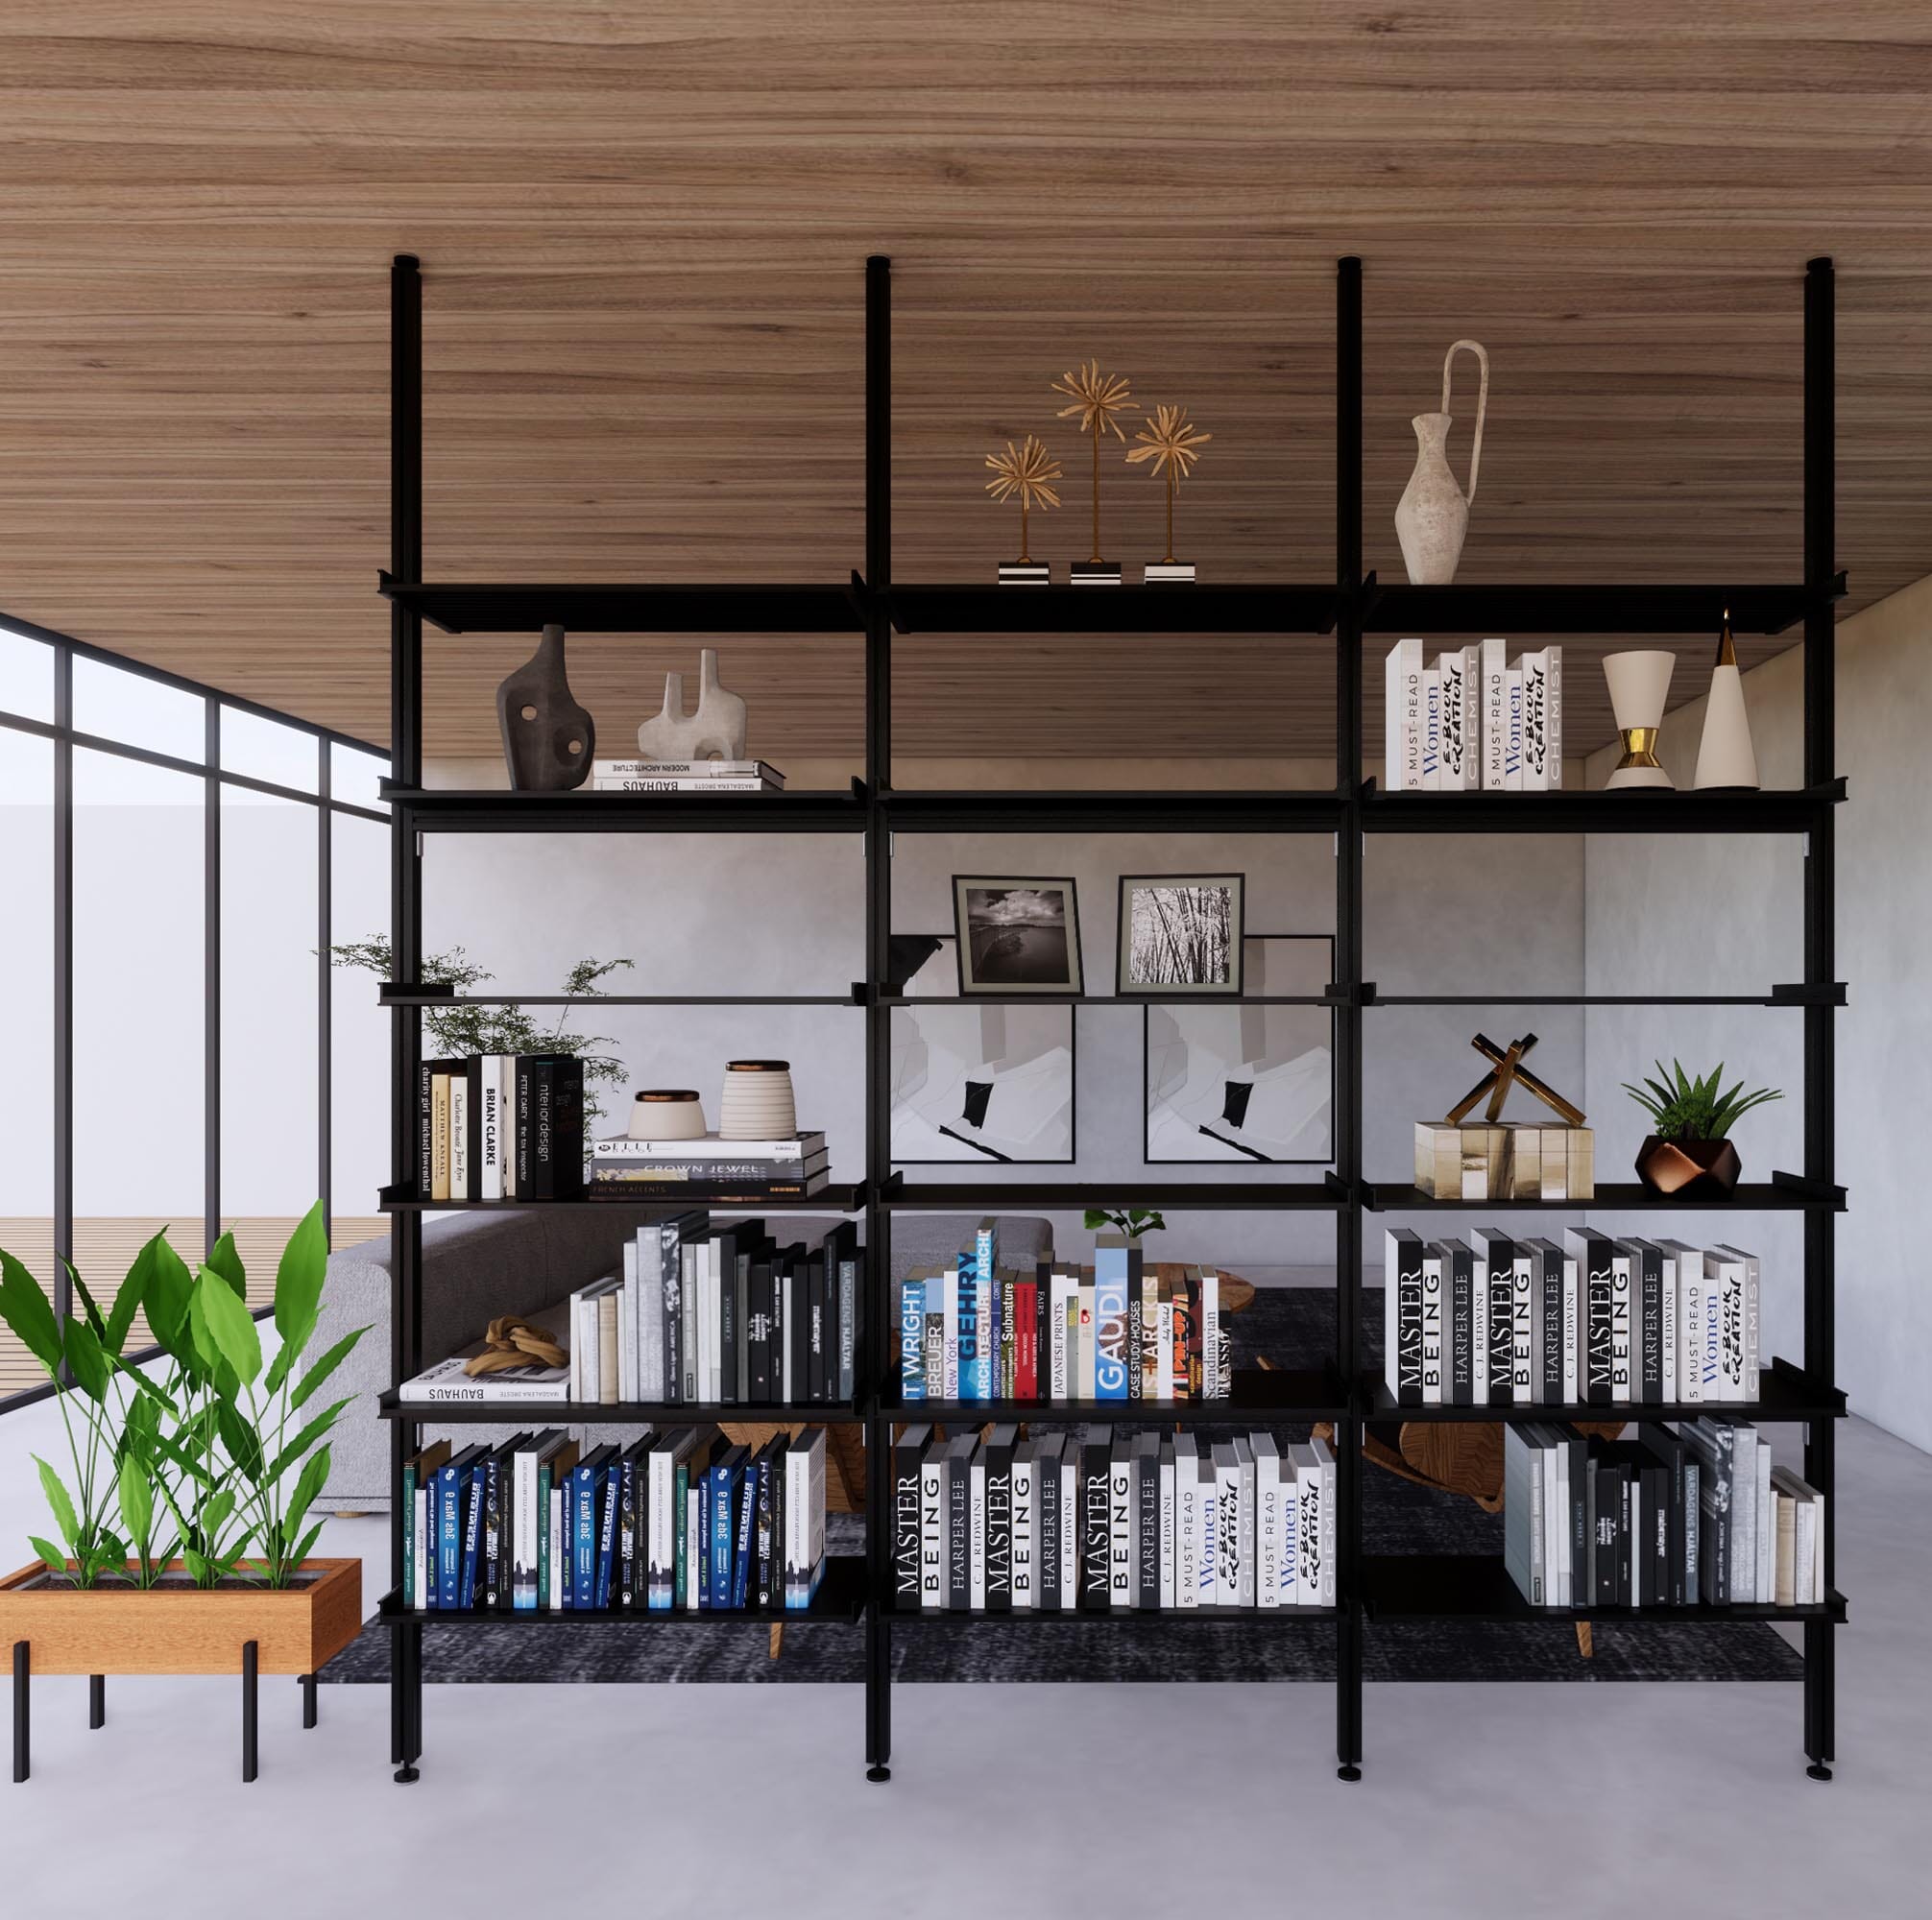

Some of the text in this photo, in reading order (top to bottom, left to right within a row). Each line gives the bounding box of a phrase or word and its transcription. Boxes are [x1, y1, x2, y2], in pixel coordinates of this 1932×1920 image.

[1409, 674, 1418, 770] MUST-READ
[1422, 685, 1438, 776] Women
[1443, 677, 1453, 765] E-BOOK
[1467, 654, 1477, 780] CHEMIST
[1491, 674, 1501, 770] MUST-READ
[1505, 685, 1521, 776] Women
[1525, 677, 1535, 765] E-BOOK
[1551, 654, 1560, 780] CHEMIST
[622, 781, 678, 791] BAUHAUS
[422, 1067, 430, 1095] charity
[422, 1097, 430, 1113] girl
[486, 1088, 495, 1165] BRIAN CLARKE
[538, 1123, 550, 1162] design
[644, 1164, 759, 1174] CROWN JEWEL
[902, 1285, 921, 1381] WRIGHT
[958, 1252, 978, 1361] GEHRY
[978, 1287, 990, 1399] ARCHITECTURE
[1002, 1283, 1014, 1342] Subnature
[1054, 1303, 1064, 1394] JAPANESE PRINTS
[1130, 1300, 1141, 1399] CASE STUDY HOUSES
[1173, 1310, 1186, 1372] PIN-UP
[1399, 1268, 1422, 1389] MASTER
[1424, 1274, 1440, 1386] BEING
[1456, 1274, 1468, 1383] HARPER LEE
[1490, 1267, 1512, 1388] MASTER
[1514, 1273, 1530, 1385] BEING
[1546, 1273, 1558, 1382] HARPER LEE
[1566, 1289, 1575, 1349] REDWINE
[1589, 1266, 1611, 1387] MASTER
[1613, 1272, 1628, 1385] BEING
[1645, 1273, 1657, 1382] HARPER LEE
[1665, 1288, 1674, 1349] REDWINE
[1689, 1286, 1698, 1399] 5 MUST-READ
[1703, 1295, 1718, 1384] Women
[1722, 1289, 1733, 1375] E-BOOK
[1749, 1266, 1758, 1392] CHEMIST
[428, 1389, 484, 1400] BAUHAUS
[928, 1326, 942, 1397] BREUER
[945, 1337, 957, 1398] New York
[1203, 1310, 1217, 1400] Scandinavian
[896, 1474, 919, 1595] MASTER
[924, 1478, 939, 1591] BEING
[953, 1479, 965, 1590] HARPER LEE
[987, 1473, 1009, 1594] MASTER
[1015, 1477, 1030, 1590] BEING
[1044, 1479, 1055, 1589] HARPER LEE
[1086, 1472, 1109, 1594] MASTER
[1113, 1476, 1128, 1589] BEING
[1142, 1478, 1155, 1588] HARPER LEE
[1163, 1495, 1171, 1553] REDWINE
[1183, 1492, 1193, 1587] MUST-READ
[1198, 1499, 1215, 1590] Women
[1219, 1492, 1229, 1578] E-BOOK
[1244, 1471, 1253, 1597] CHEMIST
[1265, 1492, 1274, 1587] MUST-READ
[1280, 1499, 1295, 1589] Women
[1299, 1491, 1310, 1578] E-BOOK
[1324, 1471, 1334, 1597] CHEMIST
